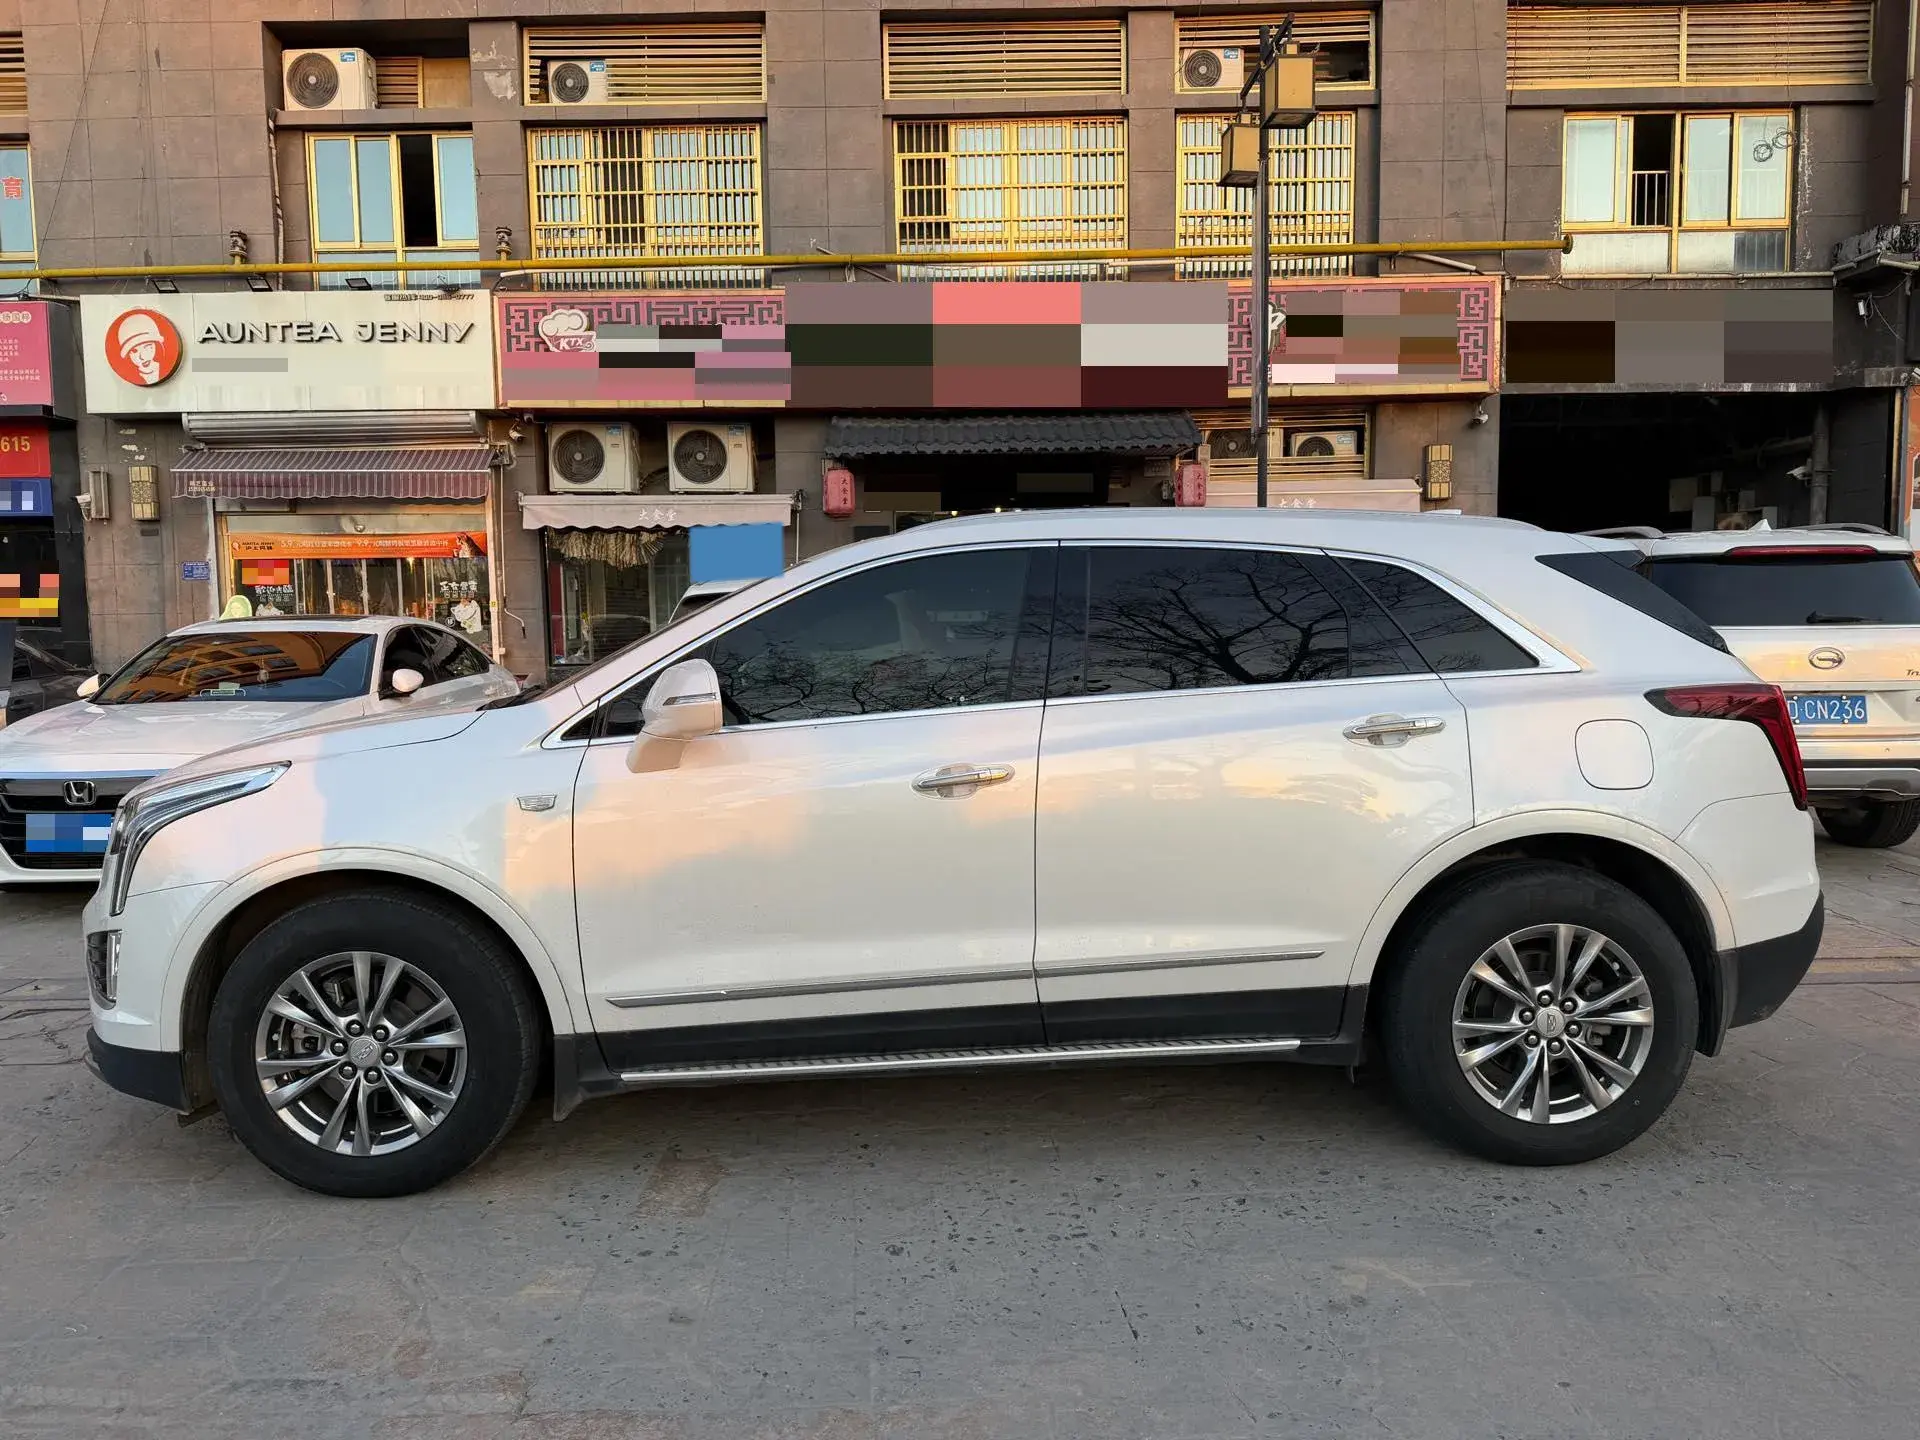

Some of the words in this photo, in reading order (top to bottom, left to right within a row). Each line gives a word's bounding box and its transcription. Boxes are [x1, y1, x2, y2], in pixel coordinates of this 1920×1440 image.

[199, 321, 342, 344] AUNTEA
[355, 321, 474, 344] JENNY
[559, 337, 584, 350] KTX
